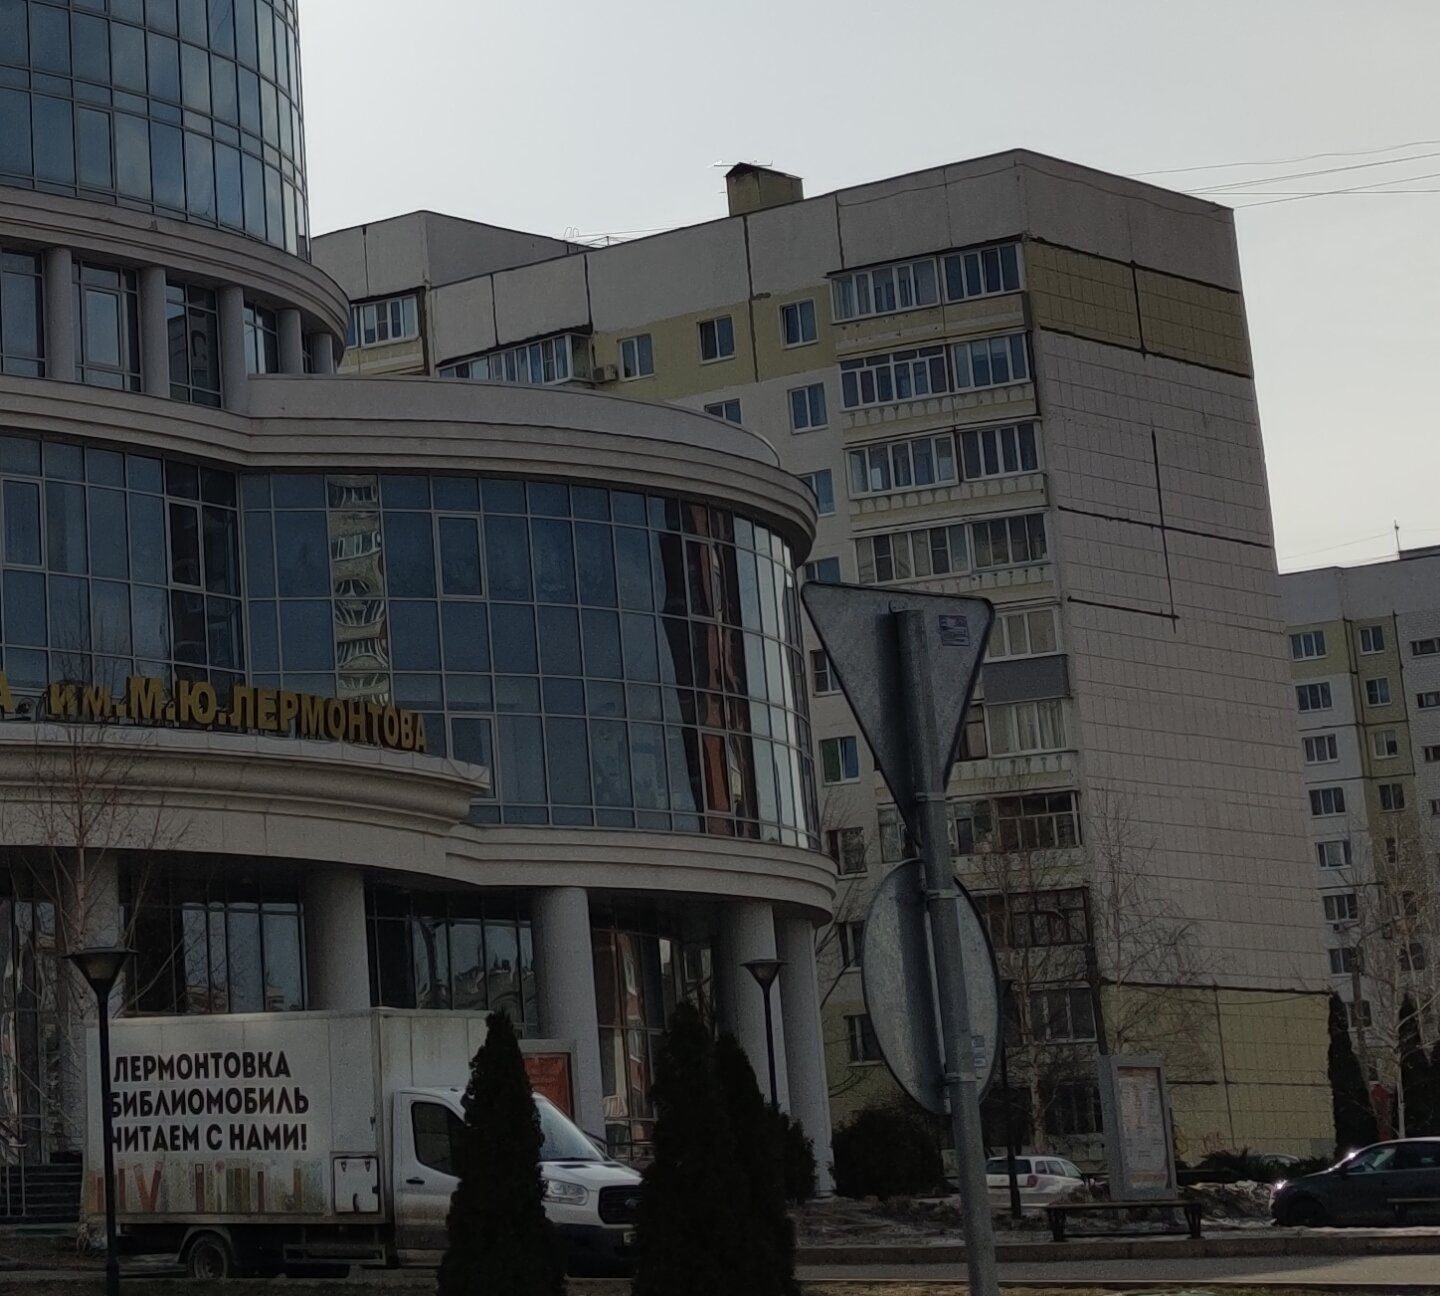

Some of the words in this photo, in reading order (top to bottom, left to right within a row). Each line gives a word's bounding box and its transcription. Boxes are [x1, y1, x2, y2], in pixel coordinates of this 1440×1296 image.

[114, 1051, 291, 1083] ЛЕРМОНТОВКА
[110, 1086, 309, 1118] БИБЛИОМОБИЛЬ
[206, 1123, 223, 1151] С
[229, 1123, 307, 1151] НАМИ!
